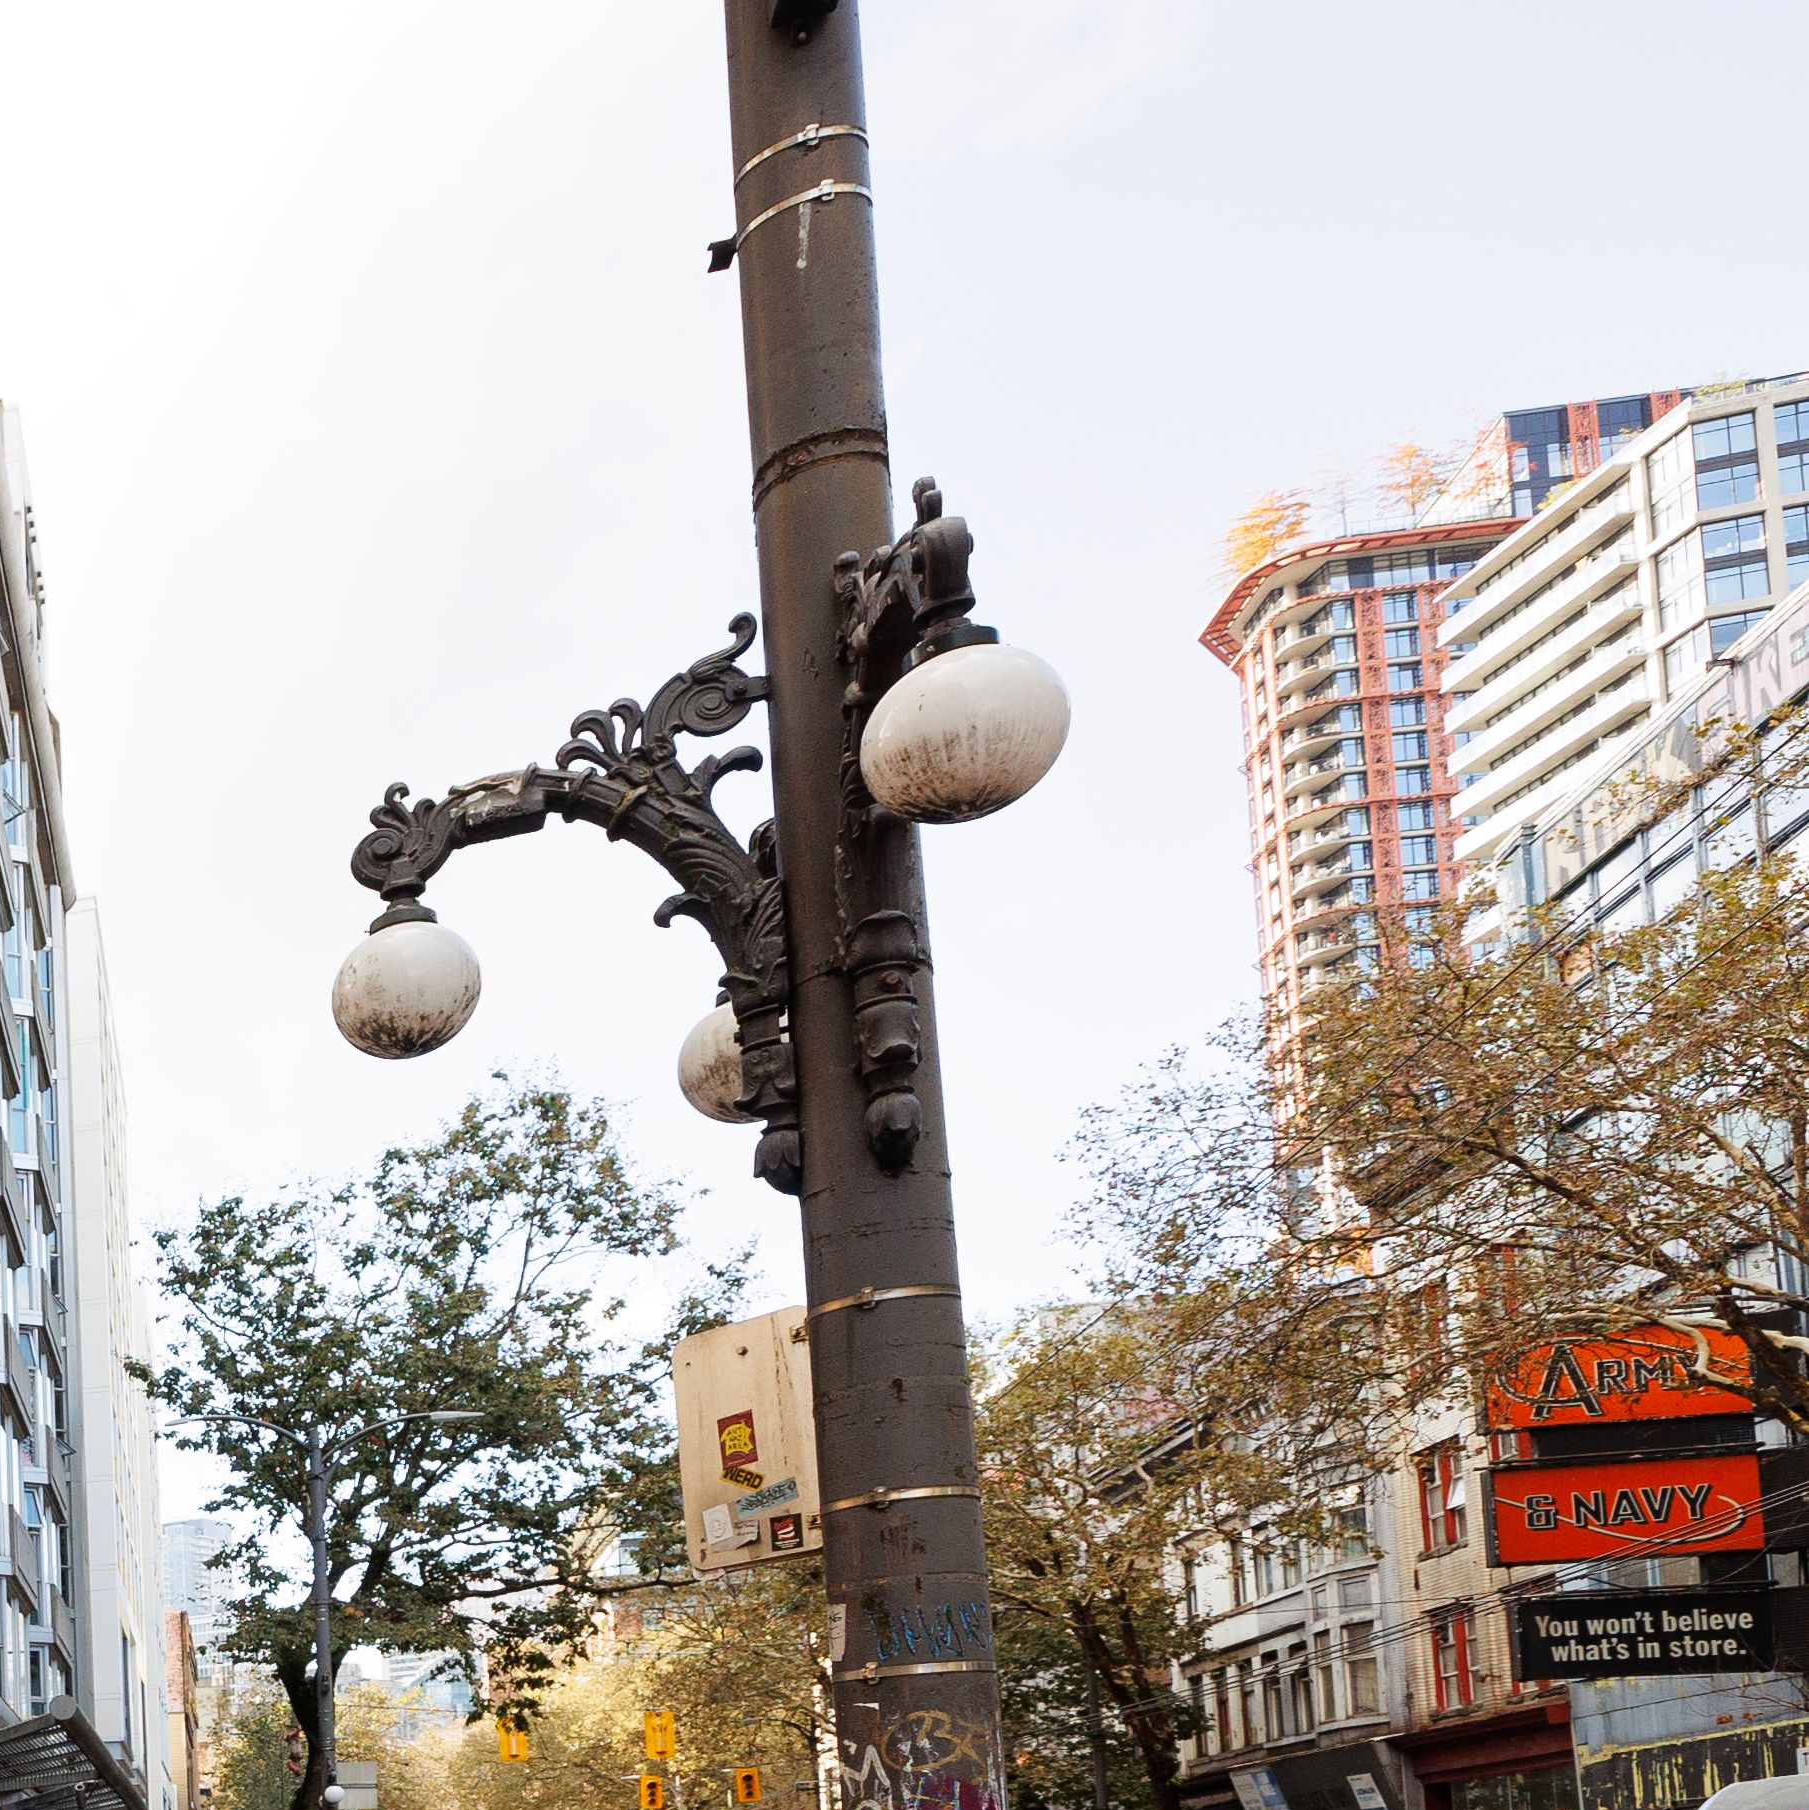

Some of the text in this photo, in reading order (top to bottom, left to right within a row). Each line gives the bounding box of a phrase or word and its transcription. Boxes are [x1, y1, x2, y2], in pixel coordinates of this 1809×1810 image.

[1531, 1343, 1702, 1420] ARMY
[1524, 1483, 1711, 1530] & NAVY
[1534, 1608, 1754, 1638] You won't believe
[1551, 1635, 1747, 1663] what's in store.
